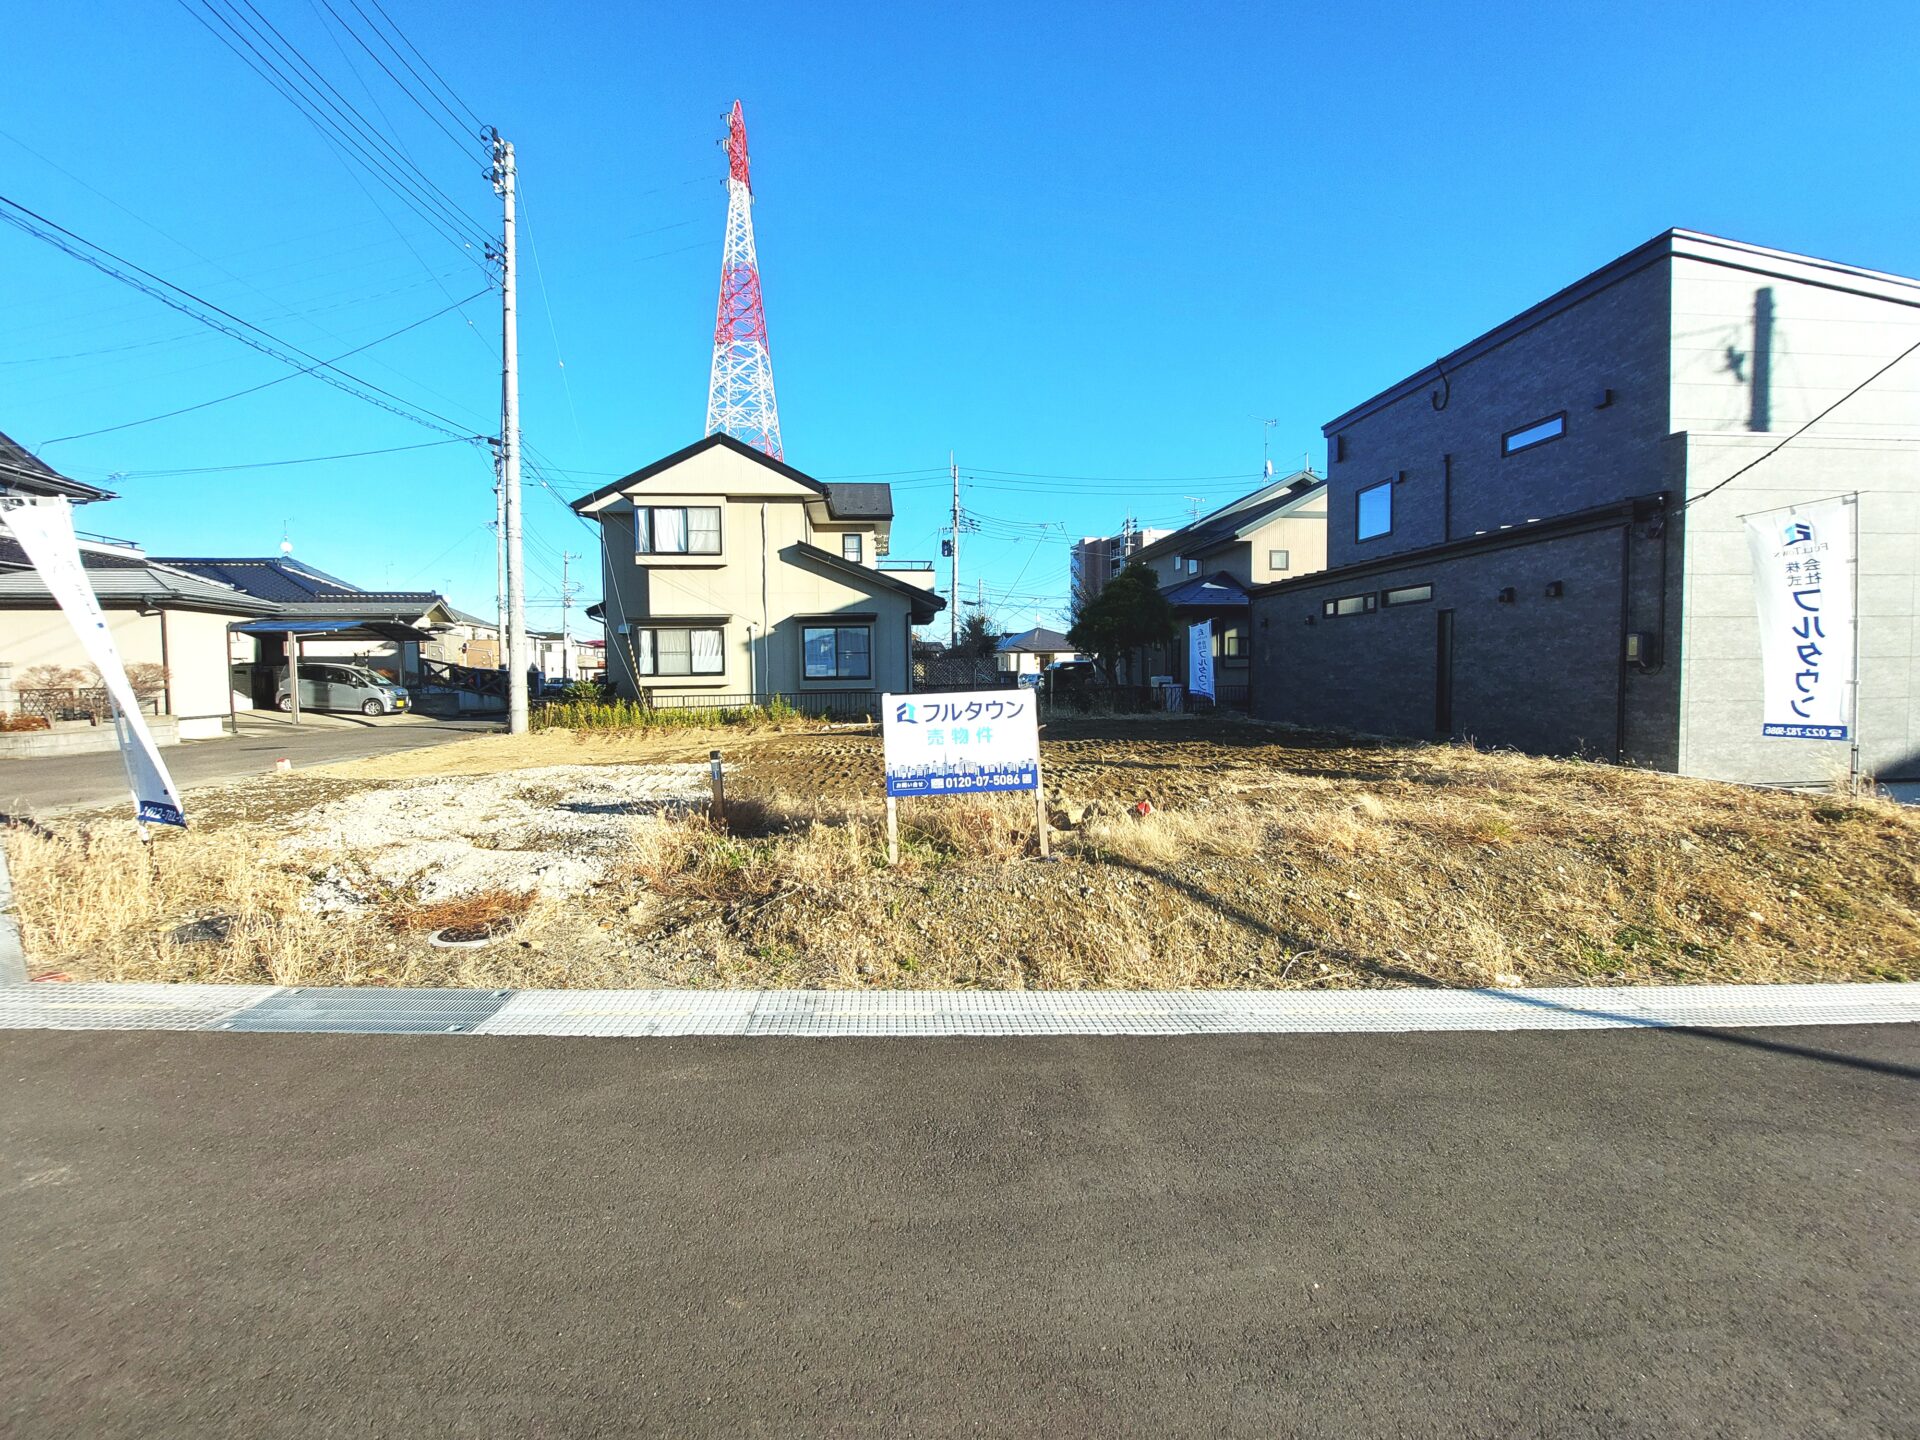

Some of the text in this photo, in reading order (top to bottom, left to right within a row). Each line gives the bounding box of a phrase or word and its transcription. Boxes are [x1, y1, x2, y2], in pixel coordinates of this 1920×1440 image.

[923, 700, 1024, 722] フルタウン
[927, 727, 993, 745] 売物件
[946, 774, 1020, 788] 0120-07-5086
